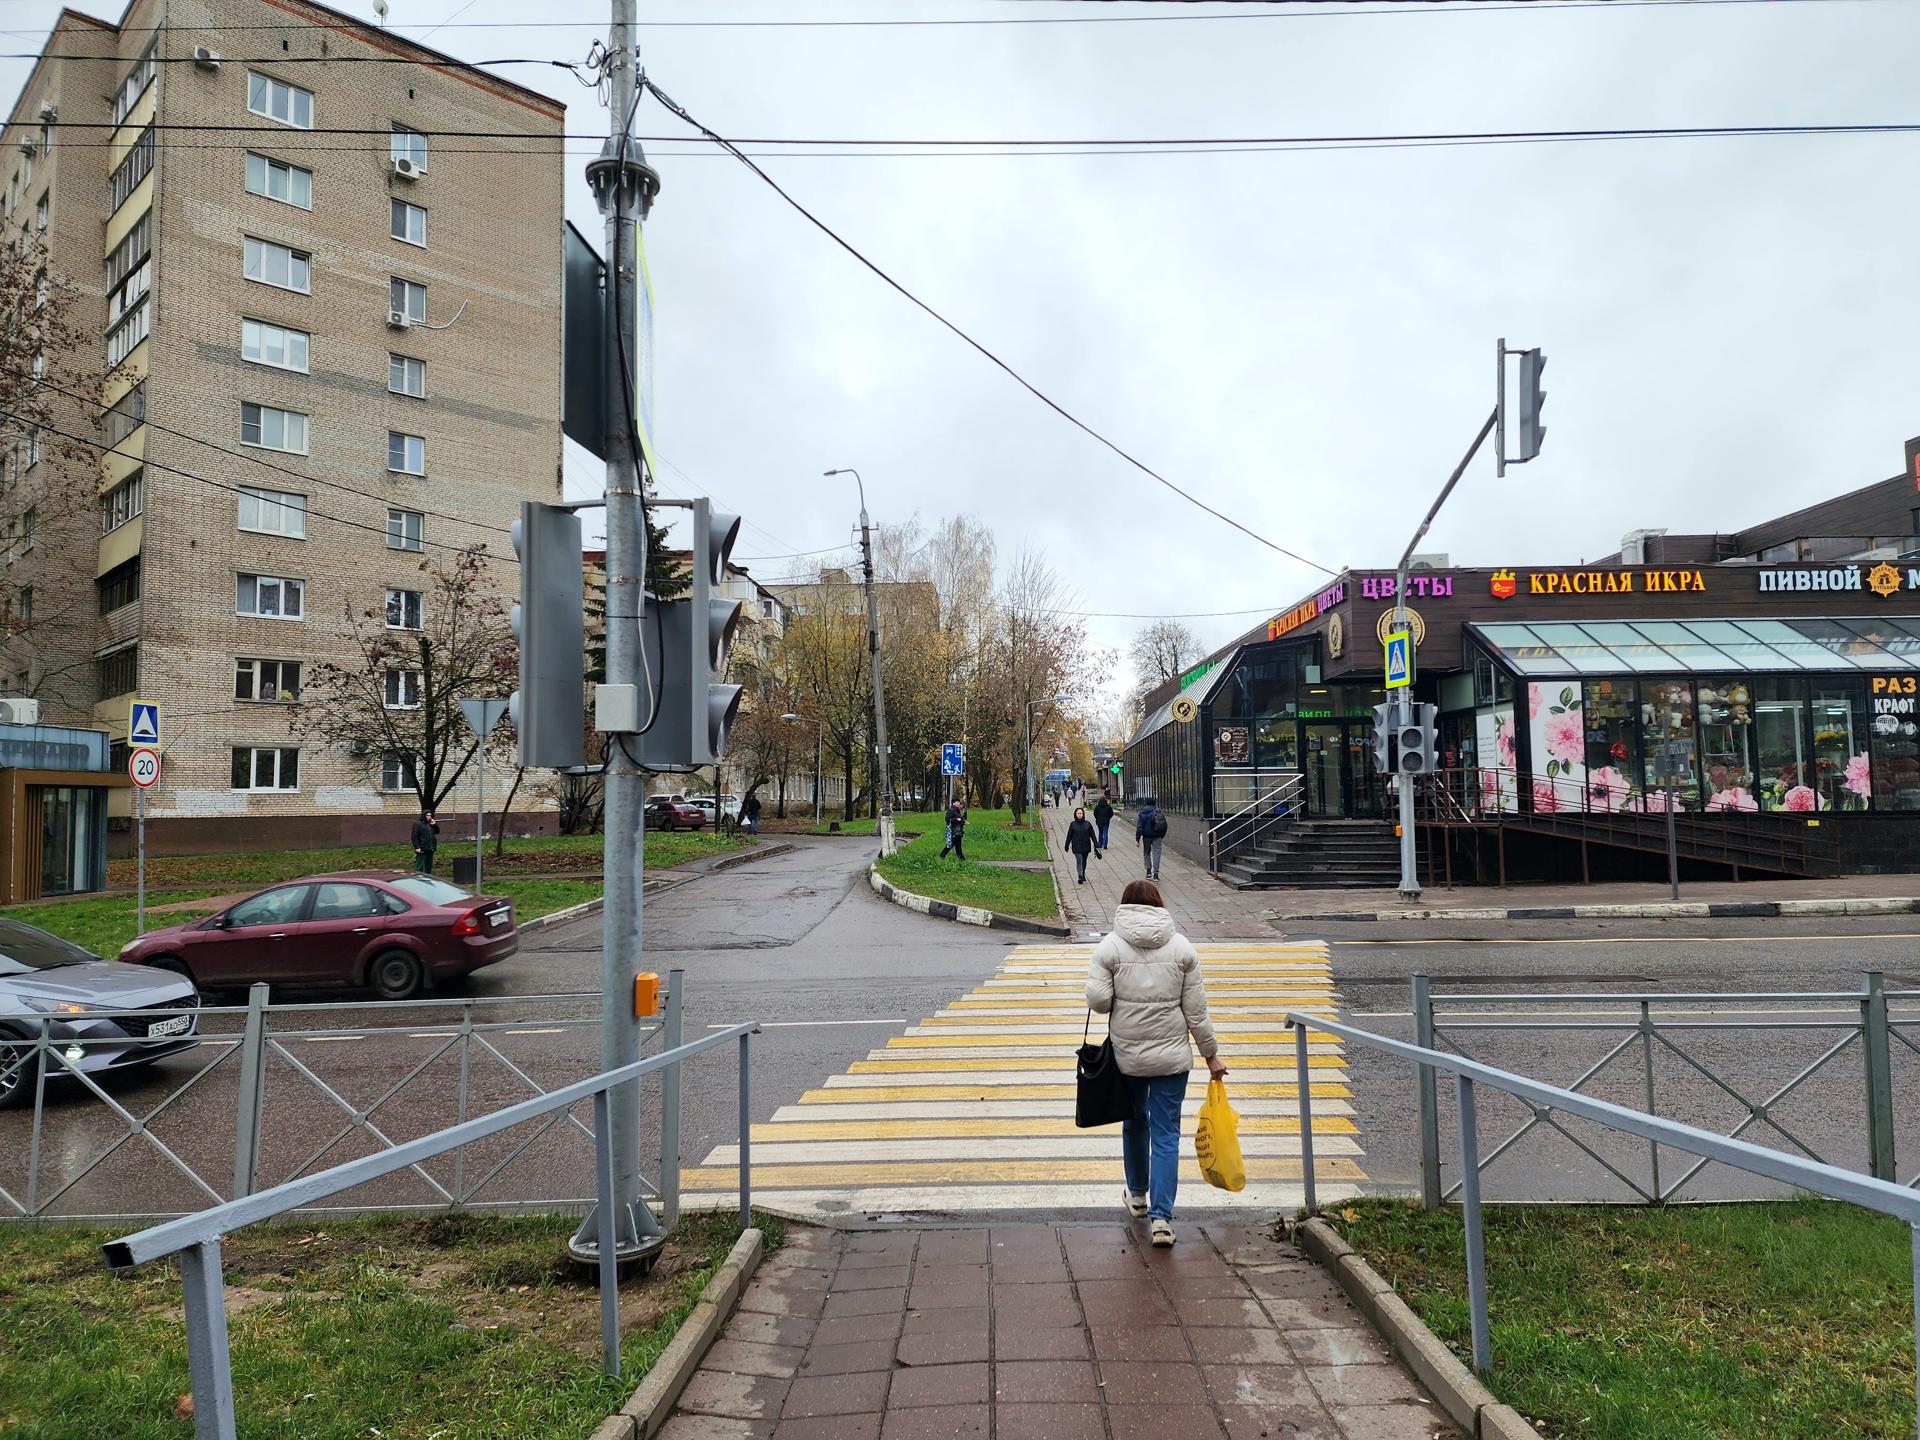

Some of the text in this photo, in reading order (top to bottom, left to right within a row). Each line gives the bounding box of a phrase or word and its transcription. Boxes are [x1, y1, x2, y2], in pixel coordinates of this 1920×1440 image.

[1529, 572, 1633, 594] КРАСНАЯ
[1645, 570, 1706, 592] ИКРА
[1759, 565, 1861, 591] ПИВНОЙ
[1317, 582, 1344, 614] ЦВЕТЫ
[1872, 677, 1917, 694] РАЗ
[1874, 698, 1915, 714] КРАФТ
[138, 759, 154, 776] 20
